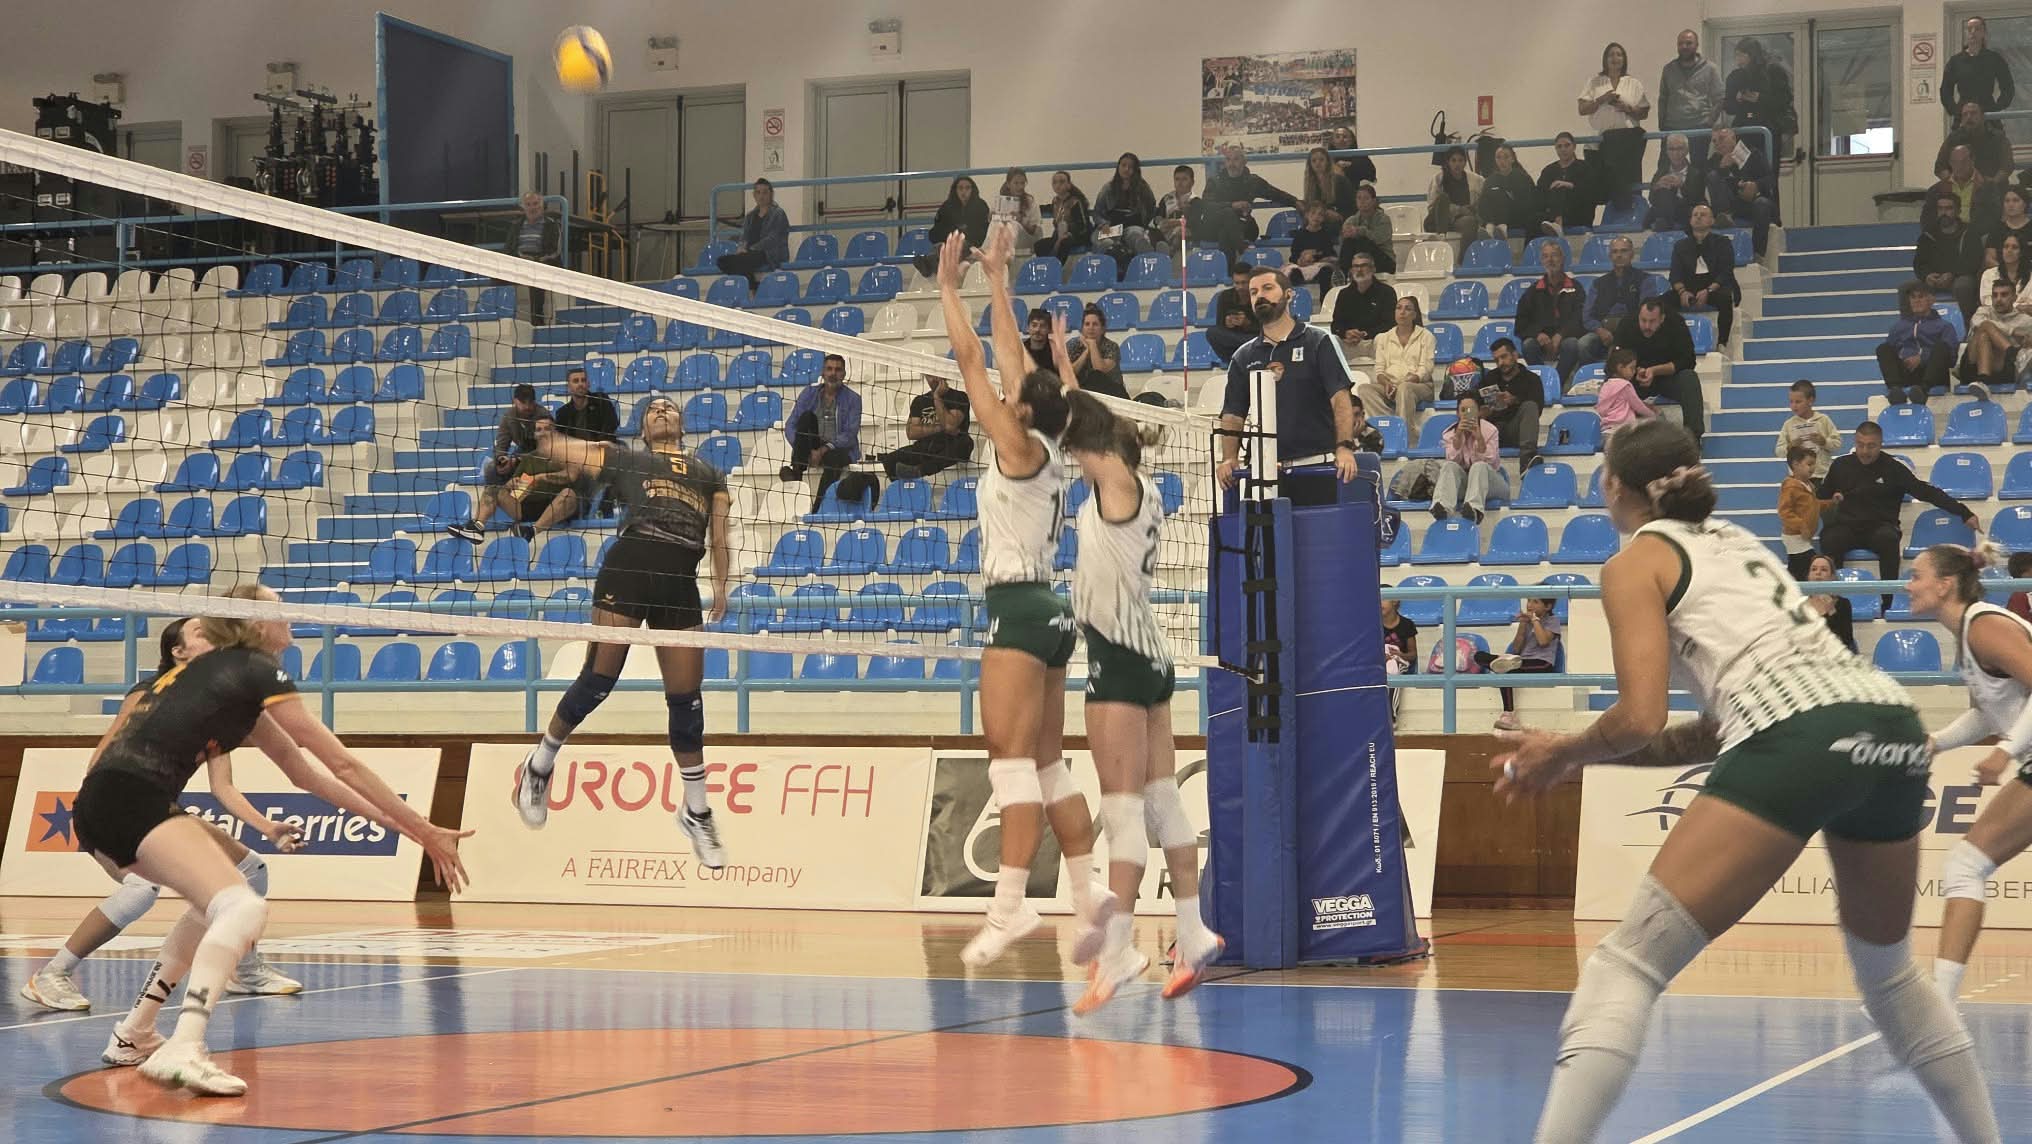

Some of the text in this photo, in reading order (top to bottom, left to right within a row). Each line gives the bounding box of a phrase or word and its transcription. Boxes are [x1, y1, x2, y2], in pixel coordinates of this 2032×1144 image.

[670, 456, 688, 475] 5
[1744, 559, 1814, 625] 2
[1368, 742, 1375, 752] EU
[1369, 753, 1377, 778] REACH
[512, 761, 875, 817] UROLFE FFH
[1372, 812, 1379, 823] EN
[561, 857, 802, 888] A FAIRFAX Company
[1313, 896, 1373, 914] VEGGA
[1320, 911, 1373, 922] PROTECTION
